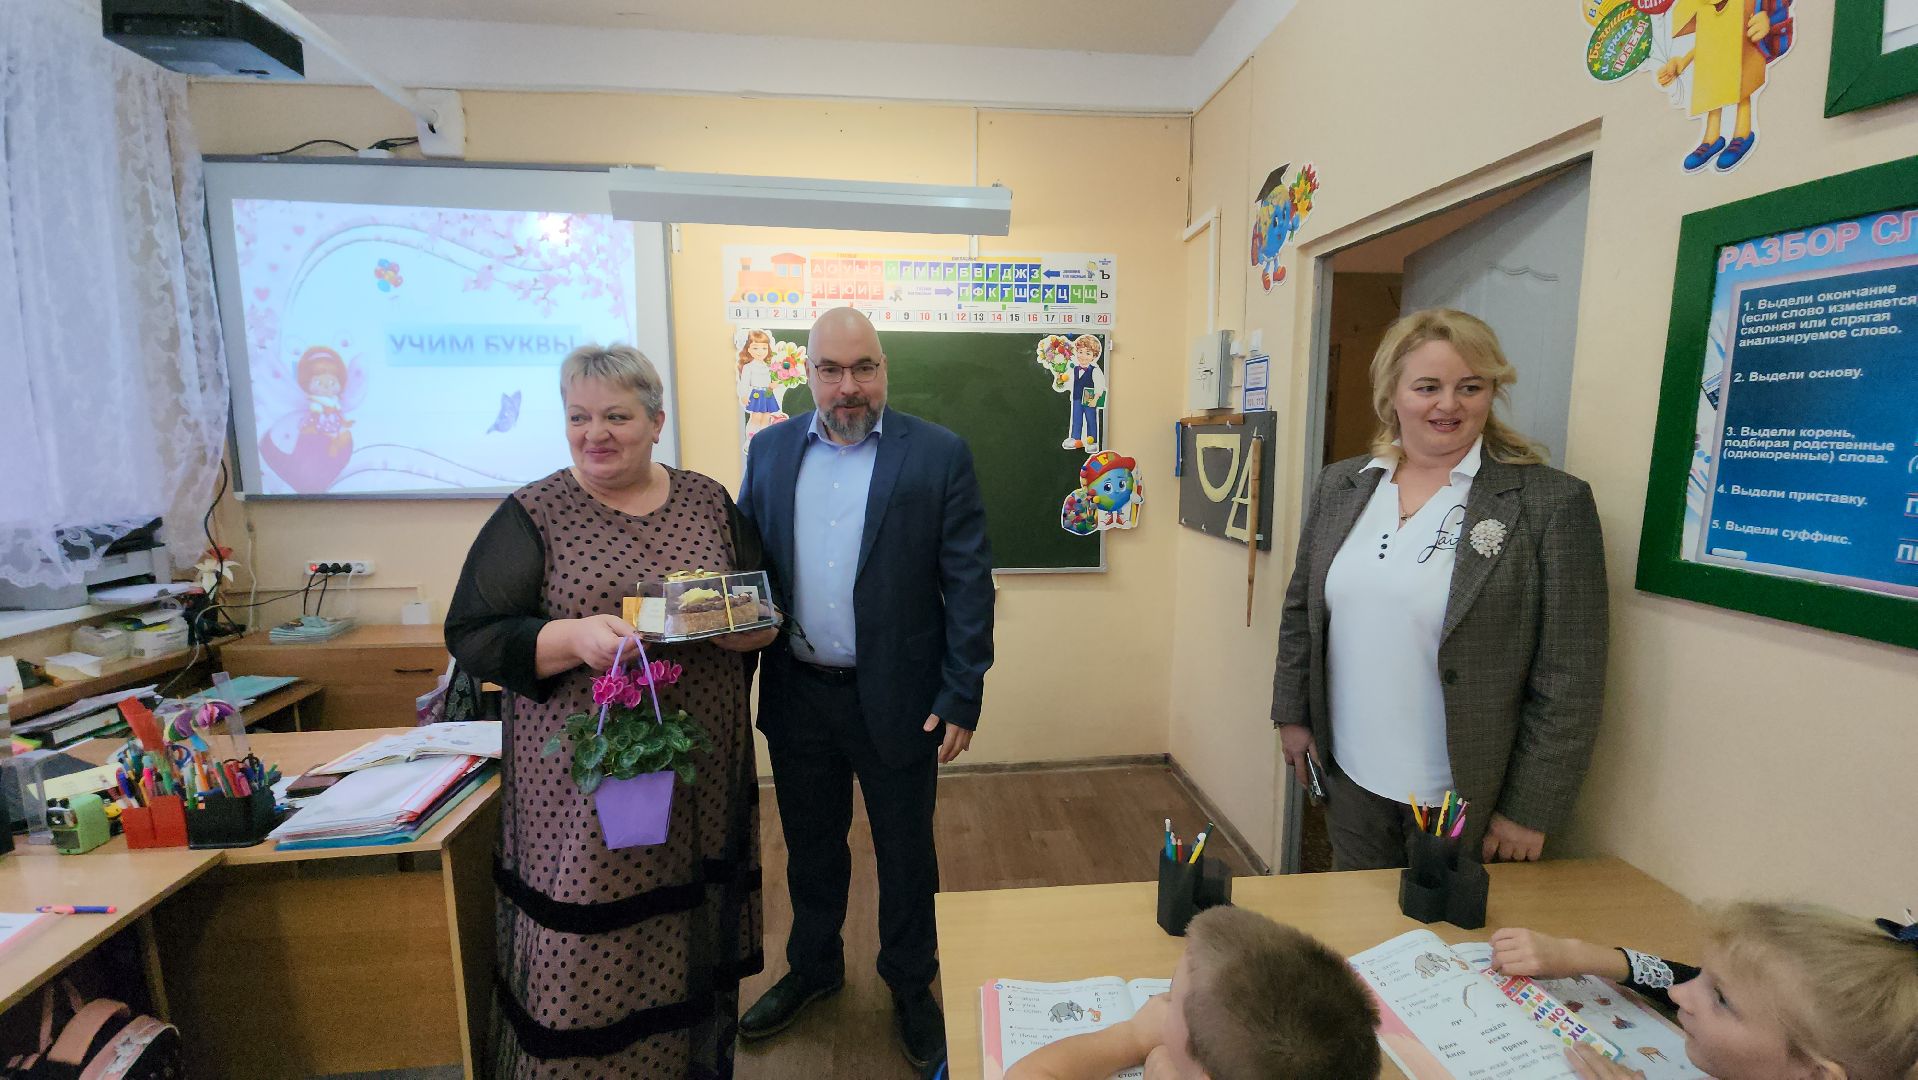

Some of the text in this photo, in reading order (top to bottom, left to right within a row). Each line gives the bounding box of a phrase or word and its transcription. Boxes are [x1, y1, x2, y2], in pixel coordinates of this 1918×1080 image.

[1718, 222, 1861, 273] РАЗБОР
[930, 267, 939, 277] Н
[945, 267, 954, 277] Р
[959, 268, 969, 278] Б
[974, 268, 983, 278] В
[988, 268, 997, 278] Г
[1001, 268, 1012, 281] Д
[1015, 268, 1028, 279] Ж
[1031, 268, 1040, 279] З
[973, 286, 984, 297] Ф
[988, 287, 998, 298] К
[1002, 287, 1012, 298] Т
[1014, 288, 1028, 298] Ш
[1030, 288, 1040, 299] С
[1044, 288, 1054, 299] Х
[1058, 288, 1068, 300] Ц
[1072, 288, 1082, 299] Ч
[1084, 288, 1097, 300] Щ
[1744, 283, 1897, 311] 1. Выдели окончание
[919, 311, 930, 321] 10
[938, 312, 948, 321] 11
[956, 312, 966, 321] 12
[973, 312, 984, 321] 13
[991, 312, 1002, 321] 14
[1010, 313, 1020, 322] 15
[1028, 313, 1038, 322] 16
[1045, 313, 1055, 322] 17
[1063, 314, 1073, 323] 18
[1081, 314, 1090, 323] 19
[1097, 314, 1108, 323] 20
[1740, 312, 1890, 336] склоняя или спрягая
[1741, 310, 1778, 325] (если
[1781, 306, 1824, 319] слово
[390, 334, 576, 354] УЧИМ БУКВЫ
[1739, 325, 1903, 347] анализируемое слово.
[1733, 367, 1864, 383] 2. Выдели основу.
[1726, 426, 1856, 440] 3. Выдели корень,
[1724, 435, 1895, 451] подбирая родственные
[1722, 448, 1889, 464] (однокоренные) слова.
[1717, 484, 1869, 507] 4. Выдели приставку.
[1711, 519, 1852, 545] 5. Выдели суффикс.
